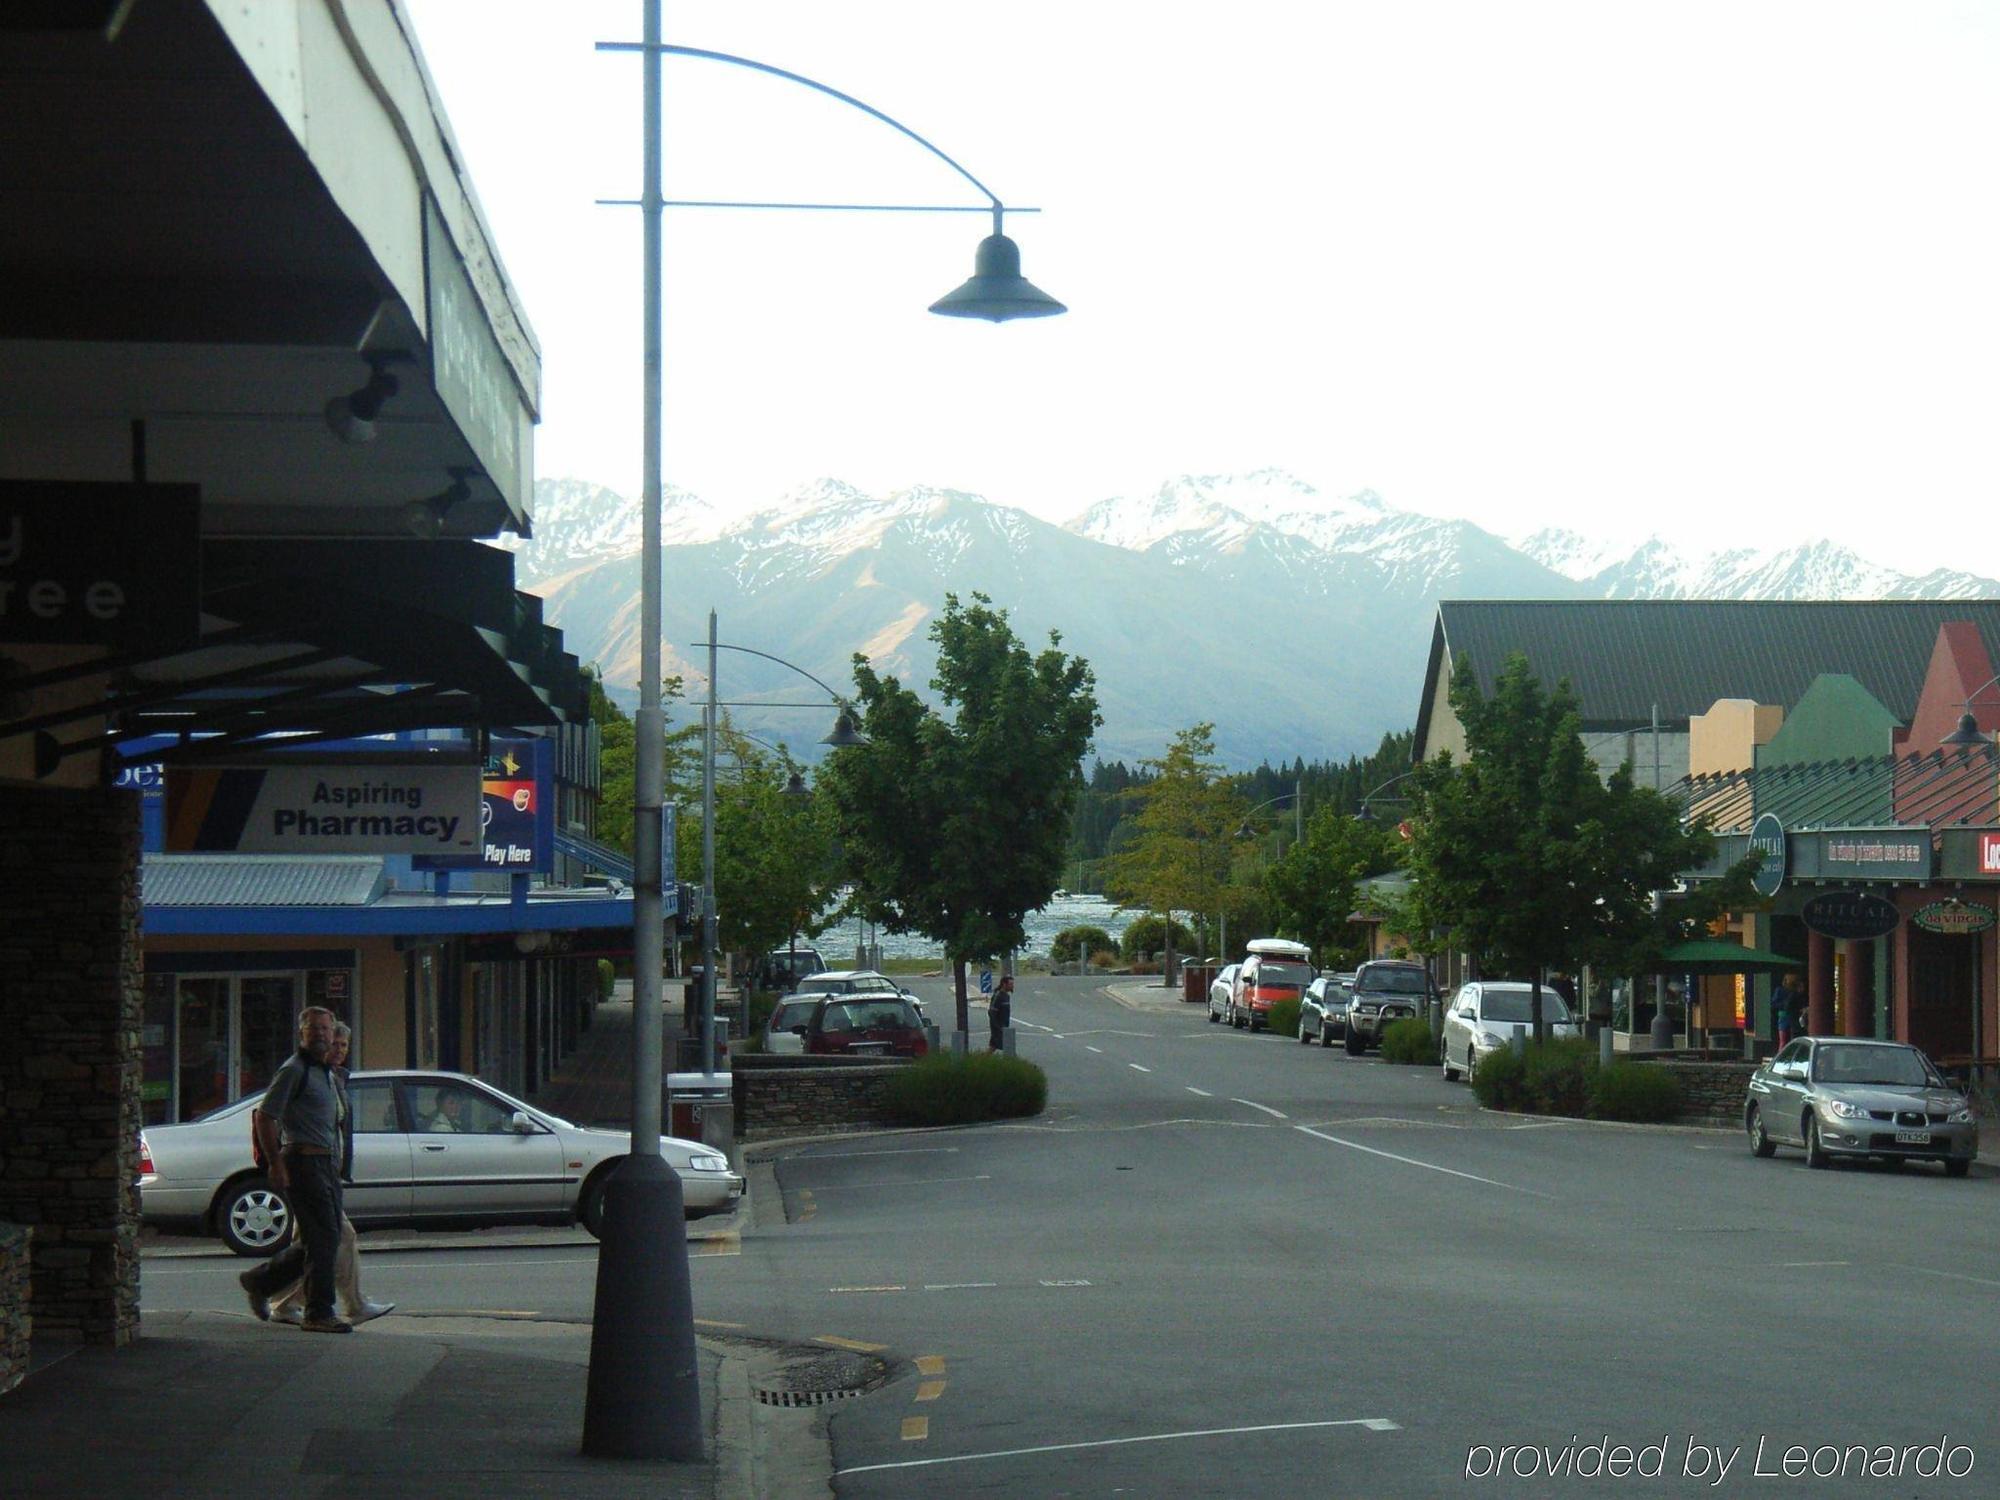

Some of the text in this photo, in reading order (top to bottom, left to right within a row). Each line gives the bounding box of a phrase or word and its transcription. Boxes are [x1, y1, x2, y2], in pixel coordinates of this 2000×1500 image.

[313, 782, 422, 809] Aspiring
[273, 809, 460, 842] Pharmacy
[484, 844, 531, 866] Play Here
